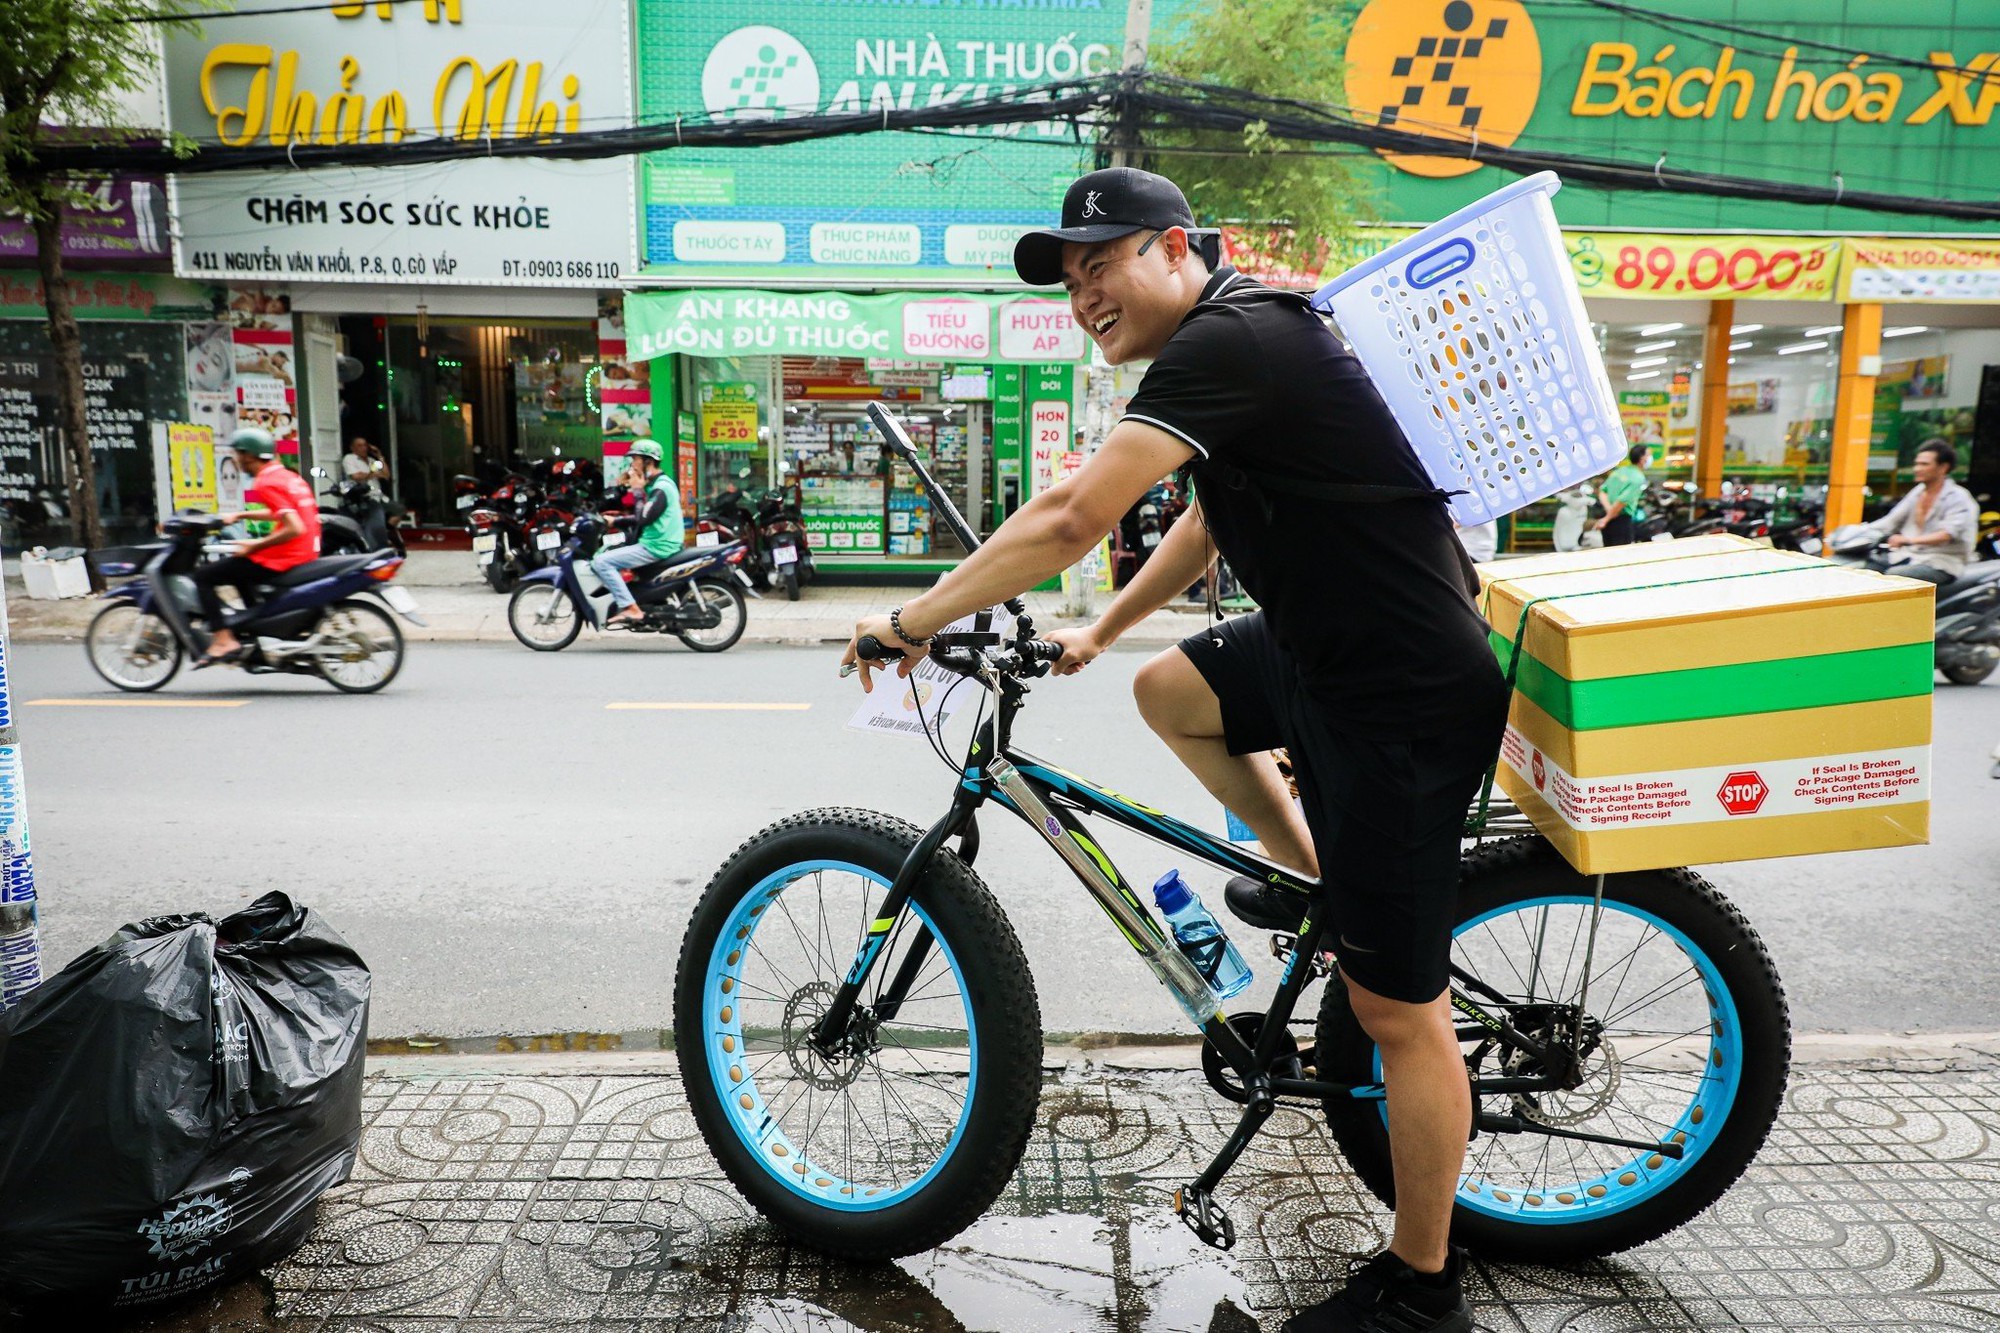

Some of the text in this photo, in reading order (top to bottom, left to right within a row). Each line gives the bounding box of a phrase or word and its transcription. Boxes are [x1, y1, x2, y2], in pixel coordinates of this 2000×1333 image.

[855, 32, 1111, 80] NHÀ THUỐC
[1571, 42, 1755, 119] Bách
[1765, 45, 1903, 122] hóa
[247, 194, 550, 230] CHĂM SÓC SỨC KHỎE
[192, 251, 218, 269] 411
[225, 246, 282, 272] NGUYỄN
[361, 257, 387, 275] P.8,
[433, 250, 457, 275] VẤP
[567, 262, 592, 279] 686
[597, 262, 619, 279] 110
[677, 298, 851, 321] AN KHANG
[927, 306, 966, 328] TIỂU
[642, 319, 889, 354] LUÔN ĐỦ THUỐC
[908, 330, 985, 350] ĐƯỜNG
[1033, 332, 1060, 351] ÁP
[1041, 430, 1060, 441] 20
[1798, 767, 1916, 786] Or Package Damaged
[1812, 759, 1901, 775] If Seal Is Broken
[1588, 781, 1673, 794] If Seal Is Broken
[1724, 783, 1761, 803] STOP
[1794, 776, 1920, 797] Check Contents Before
[1590, 795, 1635, 805] Package
[1638, 789, 1687, 802] Damaged
[1607, 802, 1654, 812] Contents
[1656, 799, 1691, 808] Before
[1814, 789, 1899, 806] Signing Receipt
[1591, 811, 1672, 825] Signing Receipt
[121, 1270, 171, 1294] TÚI
